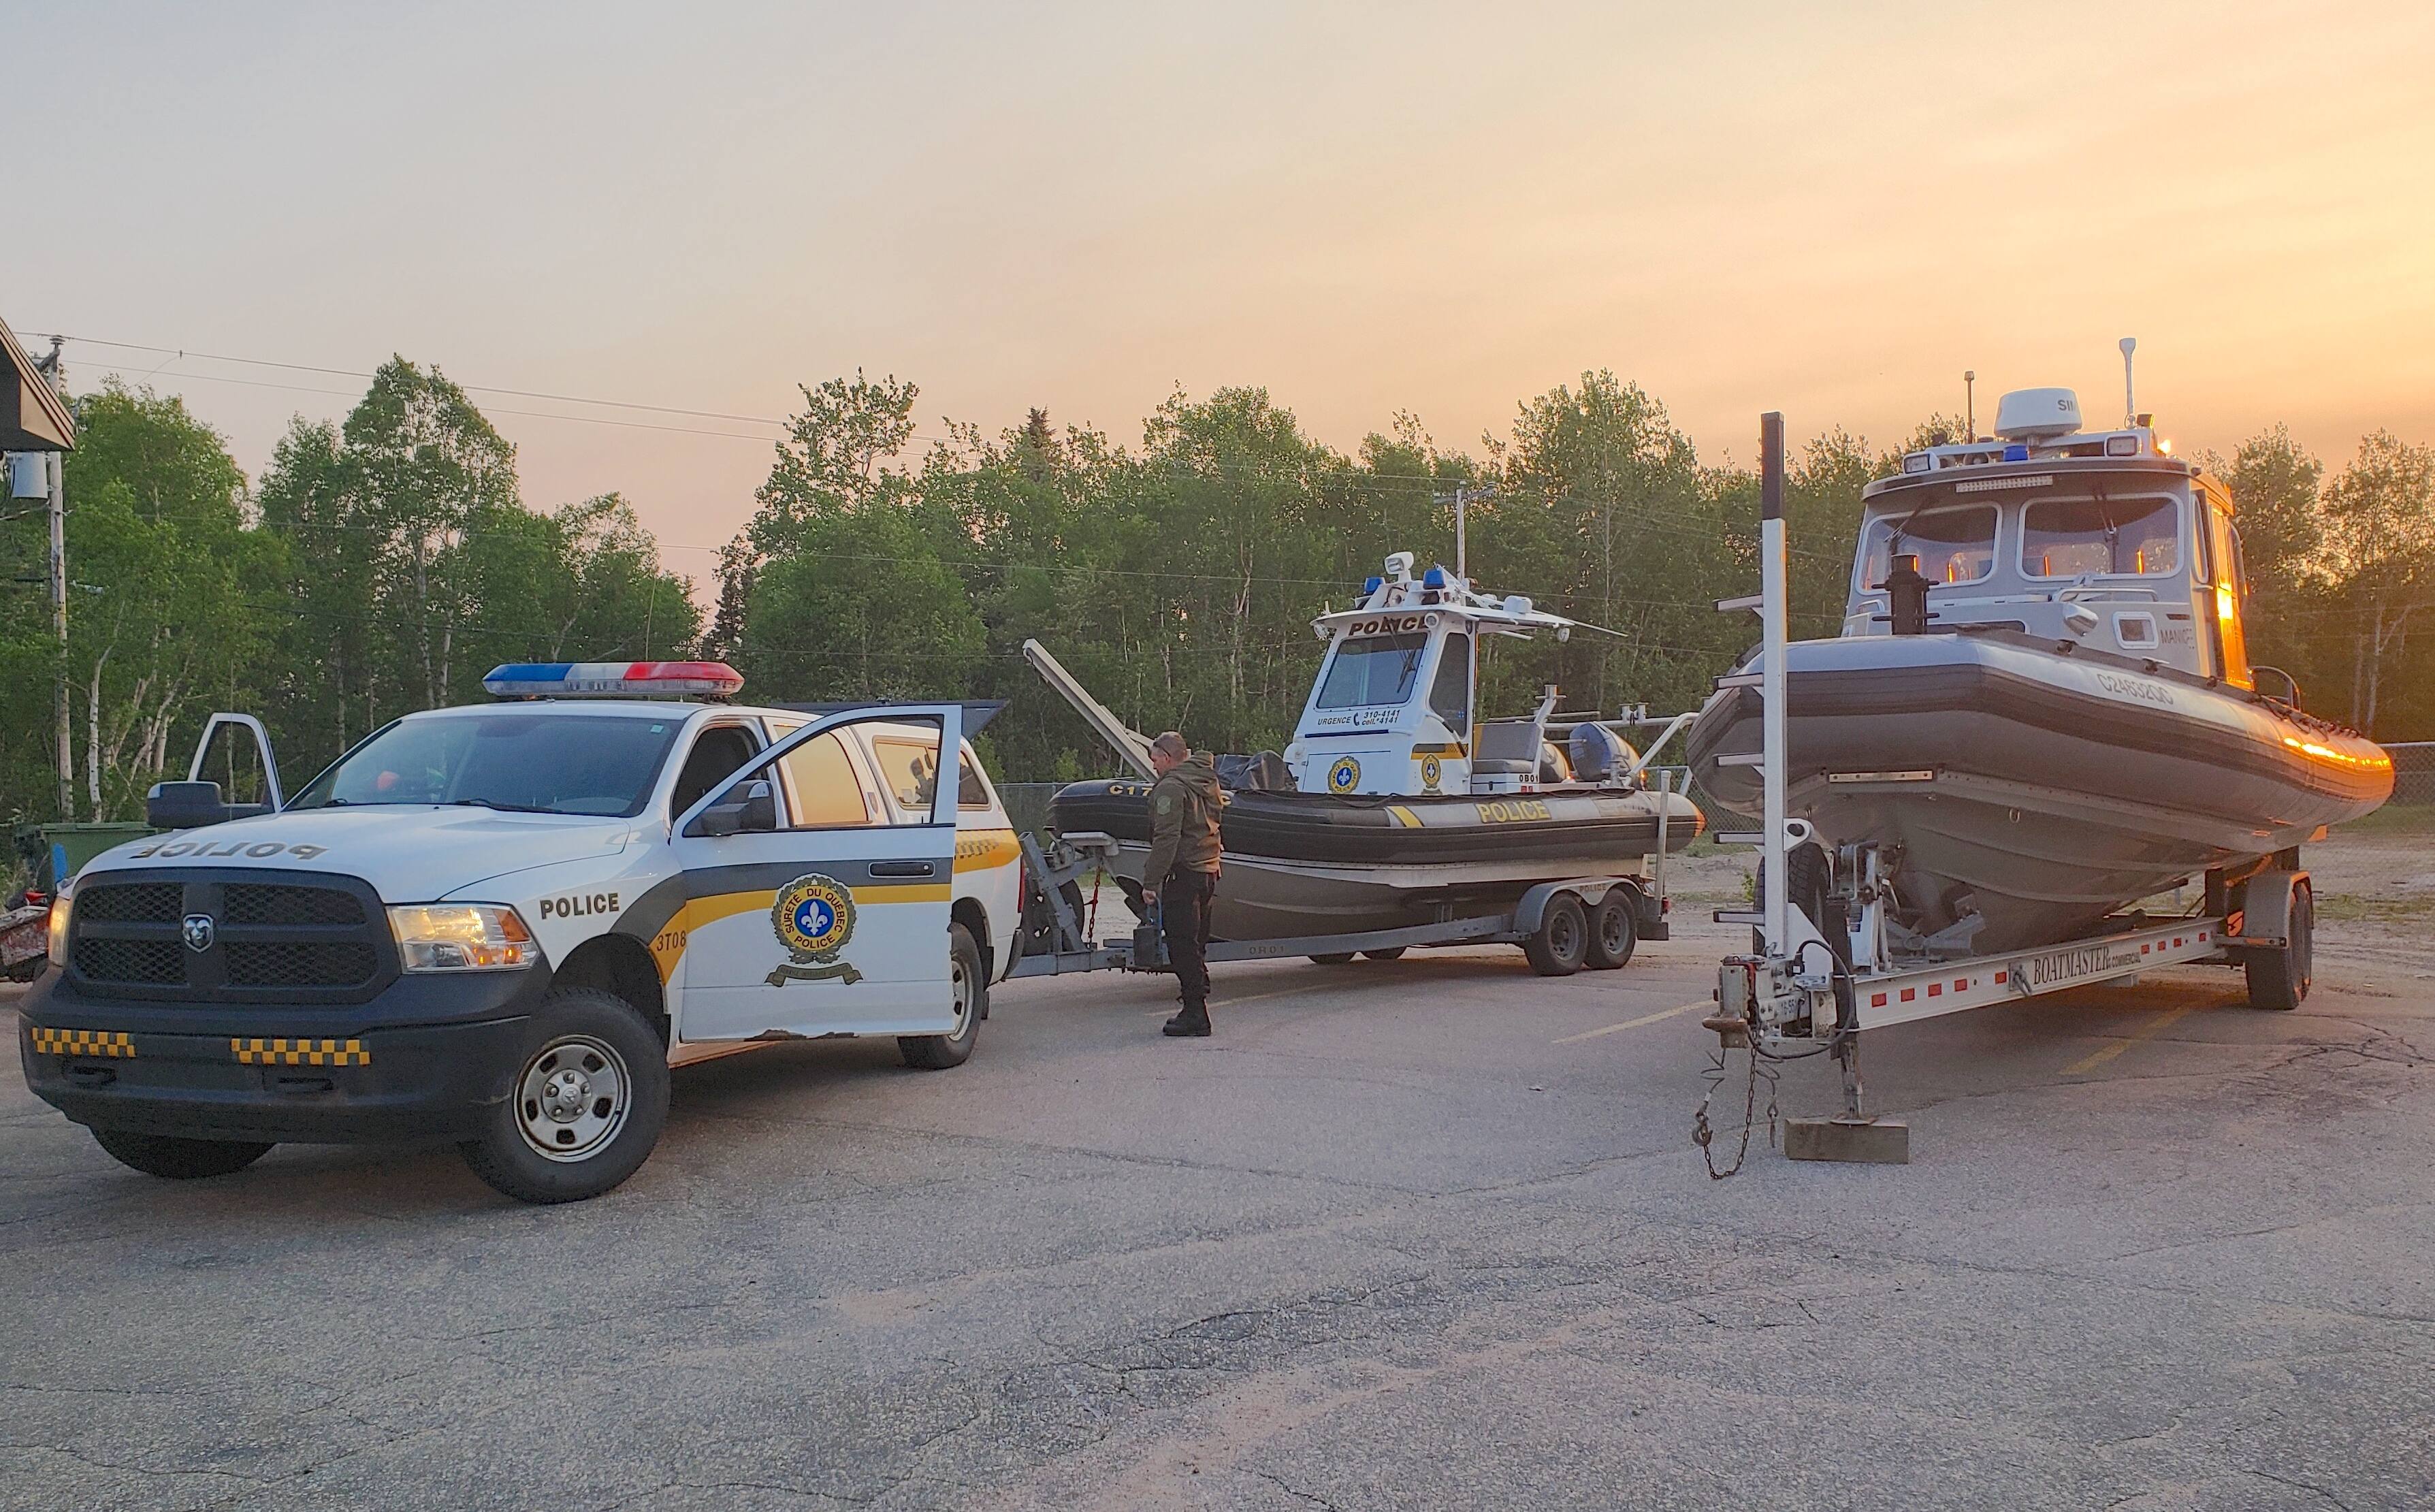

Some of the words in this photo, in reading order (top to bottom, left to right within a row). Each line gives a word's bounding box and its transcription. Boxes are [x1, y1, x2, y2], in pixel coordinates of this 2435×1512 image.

[1317, 715, 1352, 726] URGENCE
[1364, 709, 1400, 719] 310-4141
[1475, 800, 1551, 824] POLICE
[1579, 884, 1607, 892] POLICE
[540, 892, 619, 920] POLICE
[807, 888, 822, 897] DU
[825, 892, 845, 933] QUÉBEC
[657, 930, 686, 951] 3T08
[794, 933, 835, 949] POLICE
[2033, 946, 2110, 985] BOATMASTER
